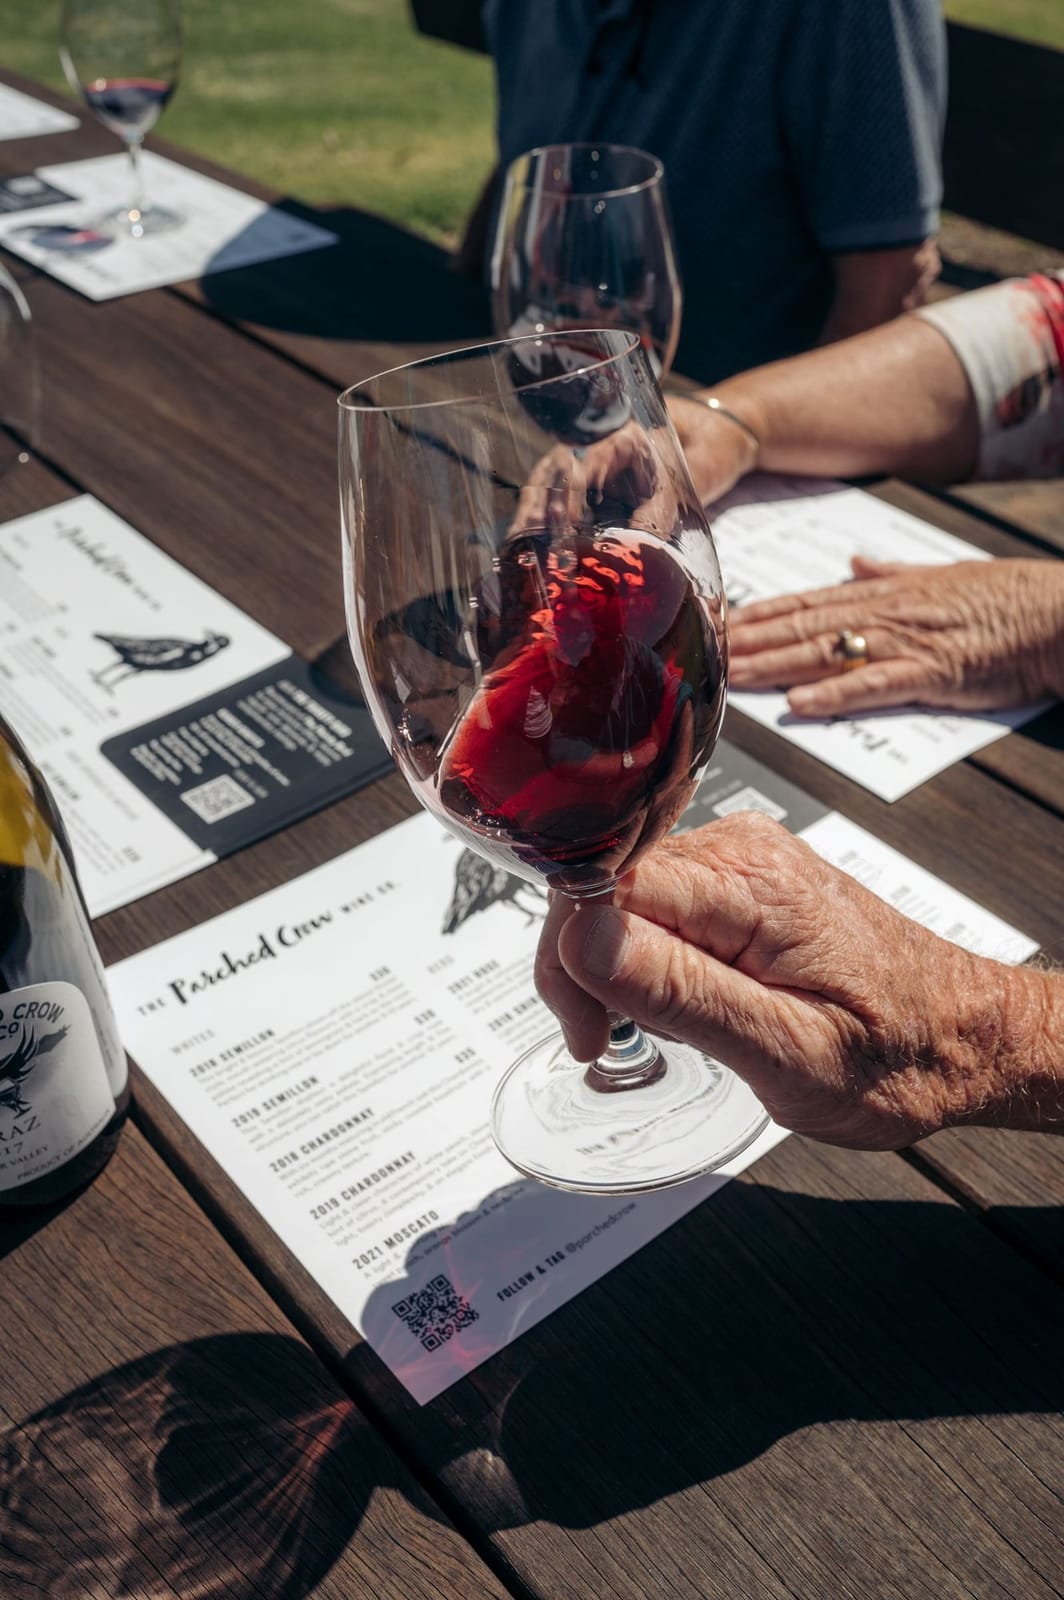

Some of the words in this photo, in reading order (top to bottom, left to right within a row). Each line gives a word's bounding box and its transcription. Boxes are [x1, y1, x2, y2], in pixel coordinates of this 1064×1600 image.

[168, 933, 276, 1006] Parched
[277, 911, 333, 947] Crow
[13, 1001, 65, 1023] CROW
[190, 1059, 217, 1077] 2018
[220, 1030, 274, 1061] SEMILLON
[232, 1108, 260, 1127] 2019
[262, 1077, 318, 1110] SEMILLON
[10, 1144, 48, 1166] VALLEY
[270, 1152, 299, 1172] 2018
[300, 1108, 373, 1154] CHARDONNAY
[310, 1198, 340, 1220] 2019
[341, 1152, 414, 1200] CHARDONNAY
[352, 1246, 383, 1269] 2021
[384, 1211, 438, 1249] MOSCATO
[497, 1272, 535, 1301] FOLLOW
[536, 1266, 546, 1274] &
[545, 1251, 565, 1266] TAG
[565, 1203, 636, 1253] @parchedcrow
